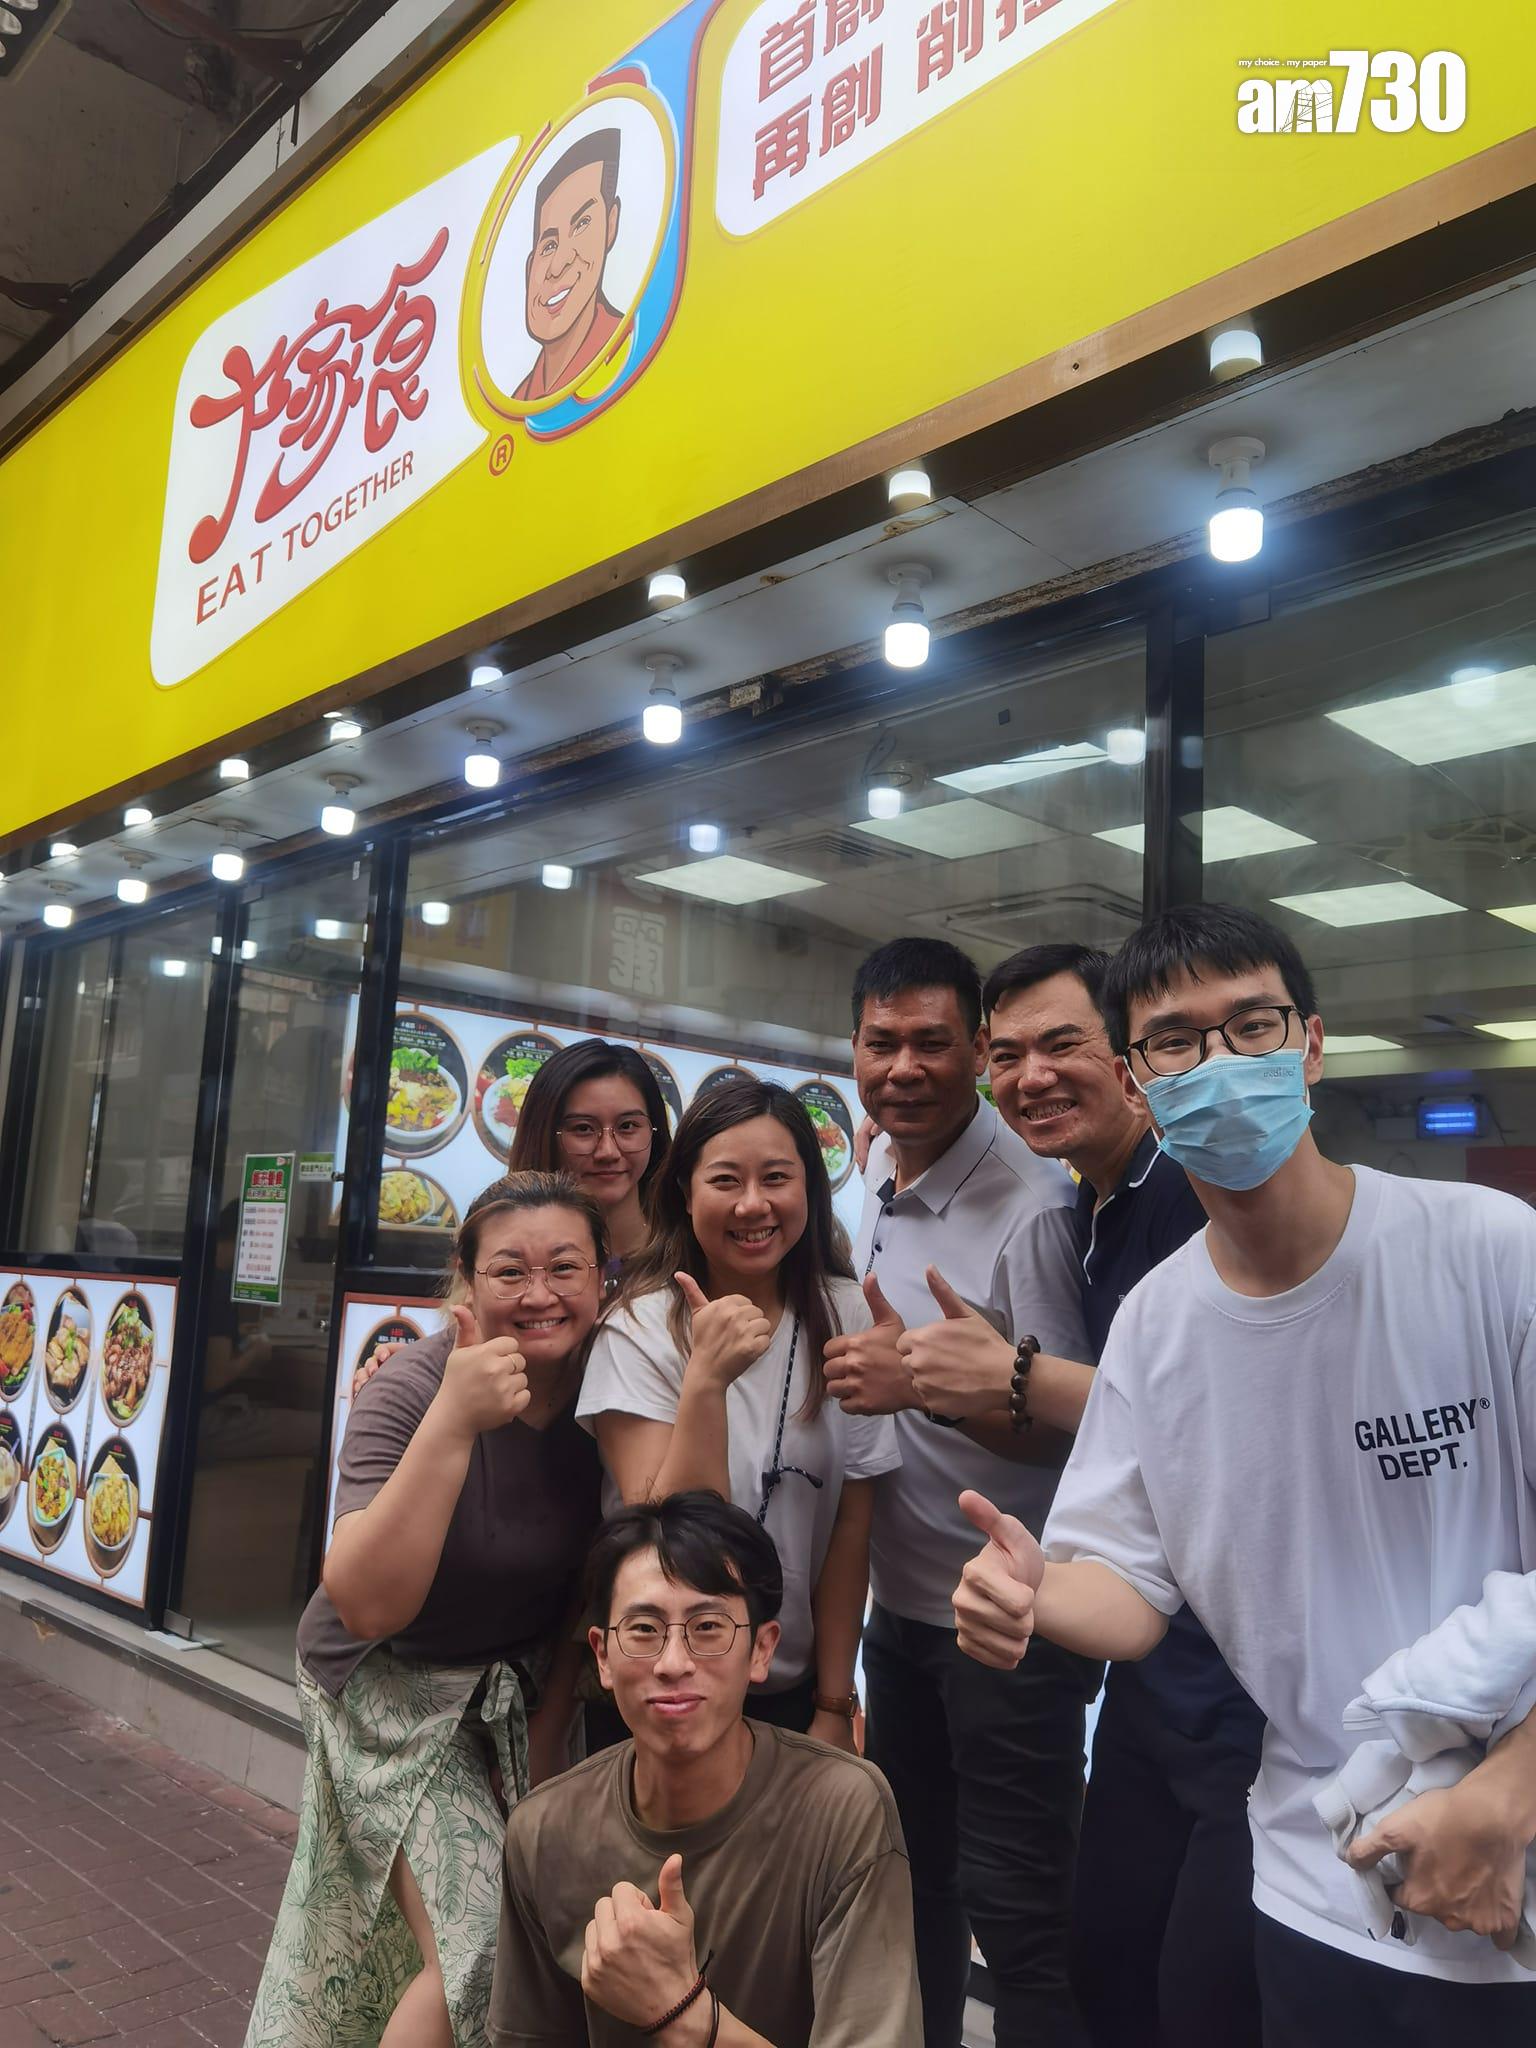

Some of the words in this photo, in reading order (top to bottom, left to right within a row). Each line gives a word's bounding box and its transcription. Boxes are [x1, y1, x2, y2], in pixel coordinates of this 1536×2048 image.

[752, 44, 884, 201] 再創
[196, 531, 272, 626] EAT
[282, 450, 414, 562] TOGETHER
[1377, 1442, 1468, 1480] DEPT.
